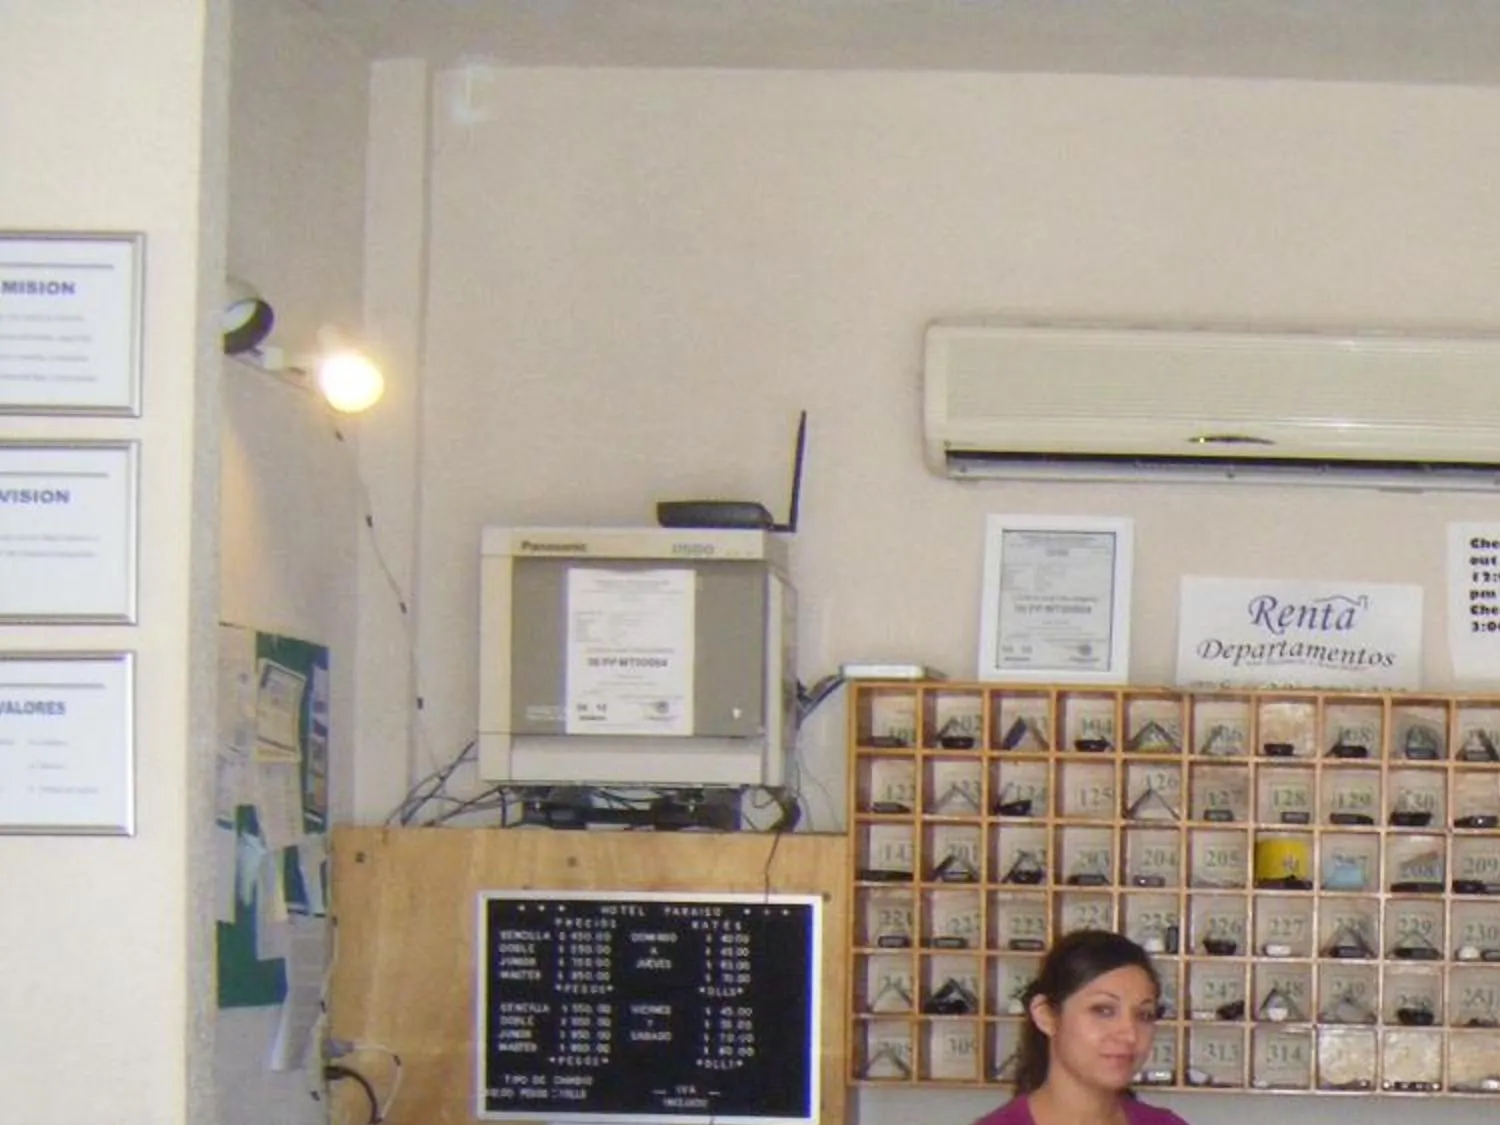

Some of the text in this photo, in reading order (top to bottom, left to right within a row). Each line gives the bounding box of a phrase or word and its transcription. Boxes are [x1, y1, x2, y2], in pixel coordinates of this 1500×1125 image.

[1, 279, 77, 296] MISION
[0, 488, 70, 504] VISION
[1470, 556, 1497, 566] out
[1470, 590, 1496, 600] pm
[1248, 594, 1358, 635] Renta
[1197, 638, 1398, 667] Departamentos
[1463, 857, 1499, 876] 209
[601, 905, 722, 918] HOTEL PARAISO
[1269, 918, 1304, 936] 227
